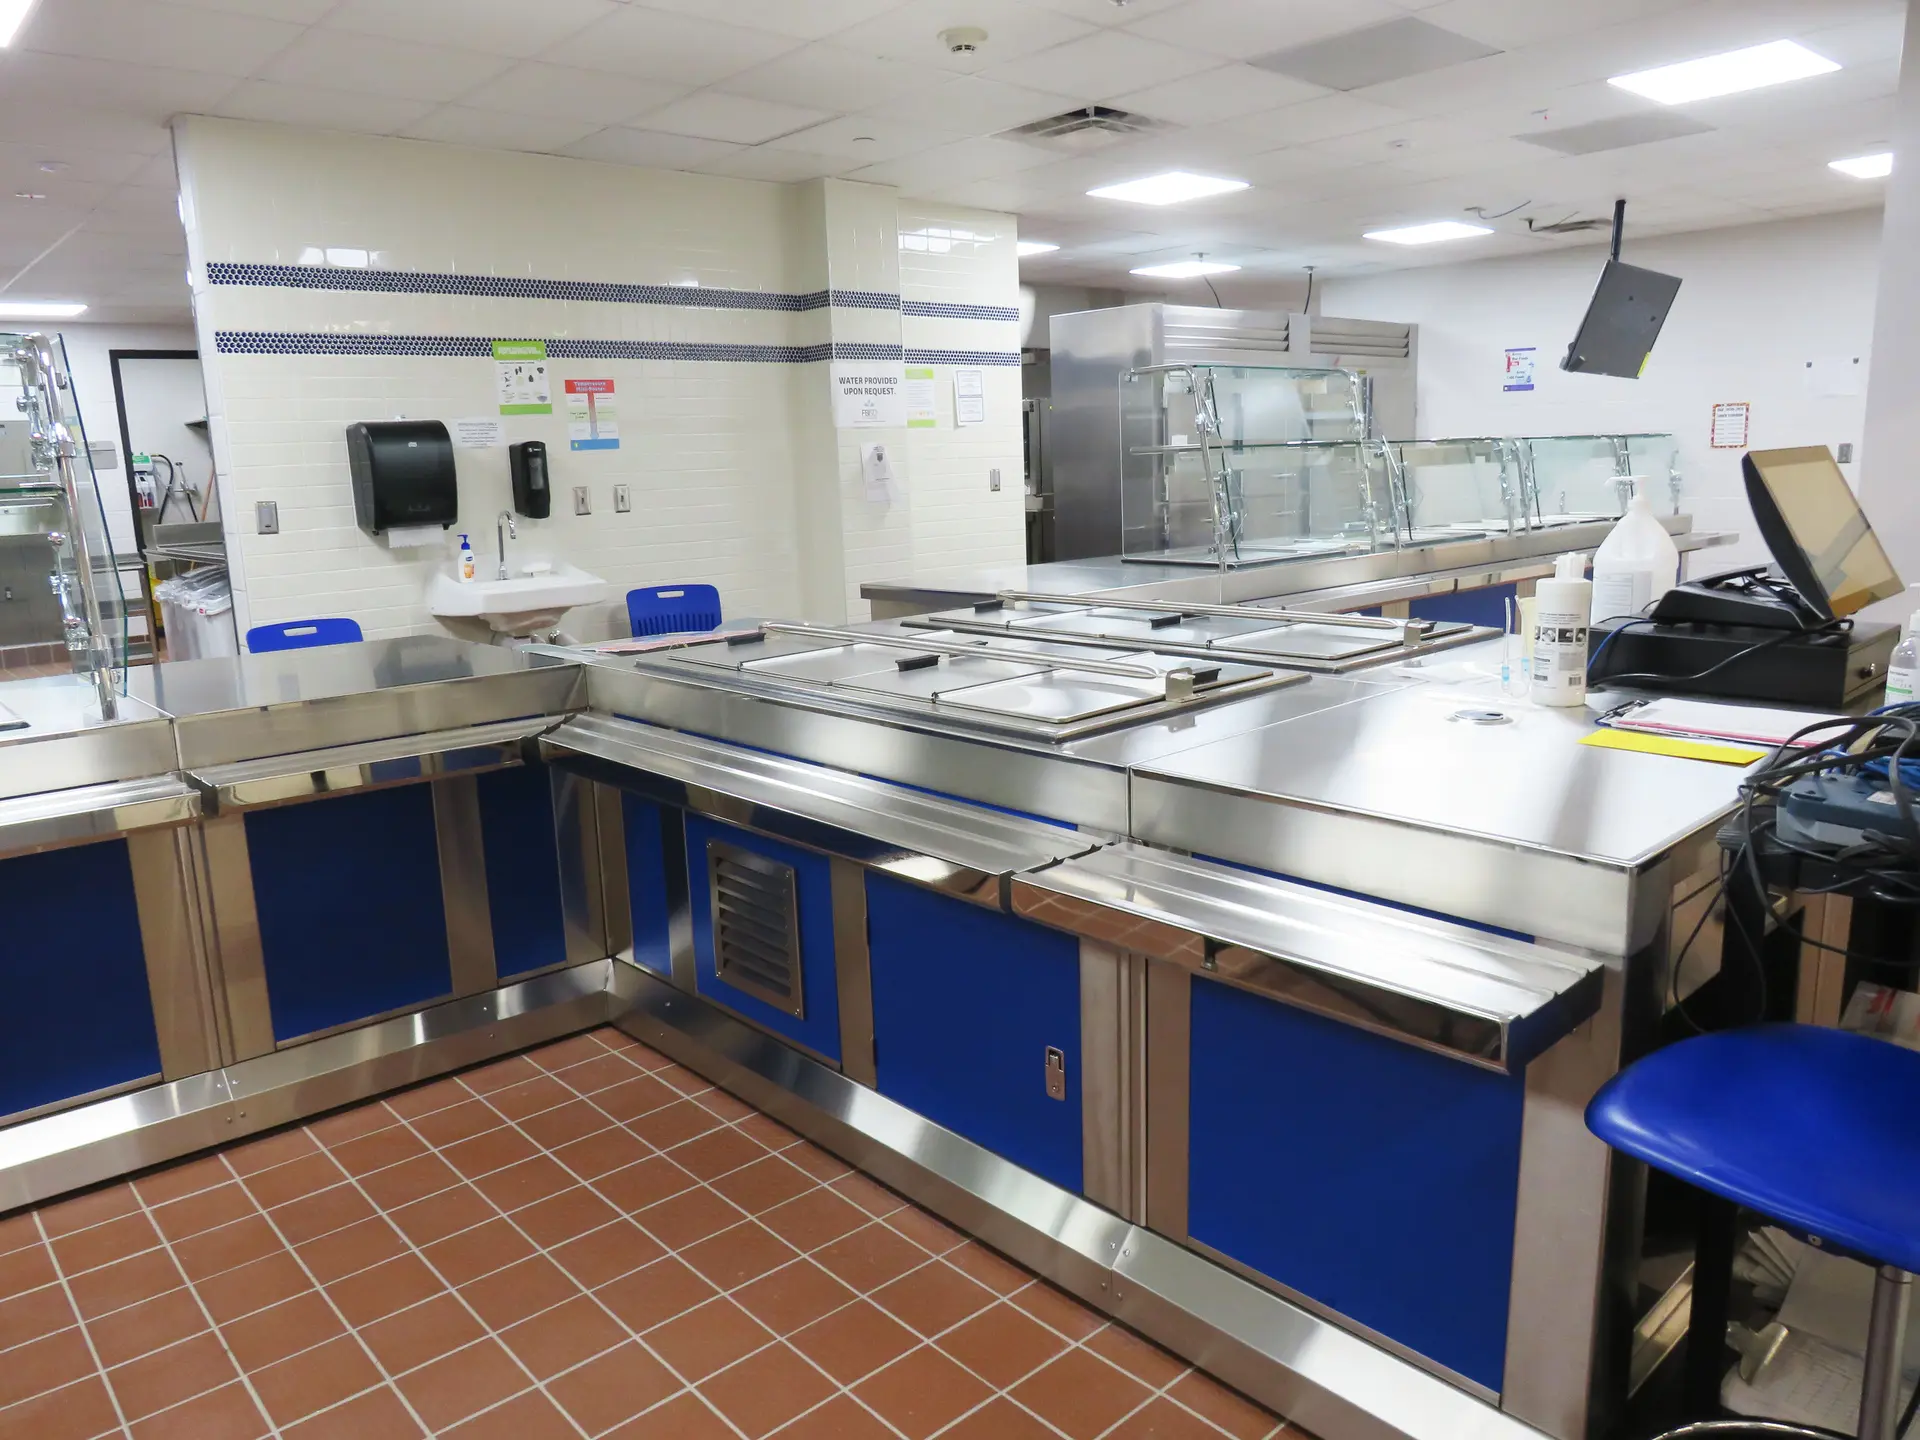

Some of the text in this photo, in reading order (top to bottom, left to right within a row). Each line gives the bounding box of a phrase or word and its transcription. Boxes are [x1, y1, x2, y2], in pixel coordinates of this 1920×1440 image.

[838, 376, 898, 385] WATER PROVIDED
[843, 387, 897, 396] UPON REQUEST.
